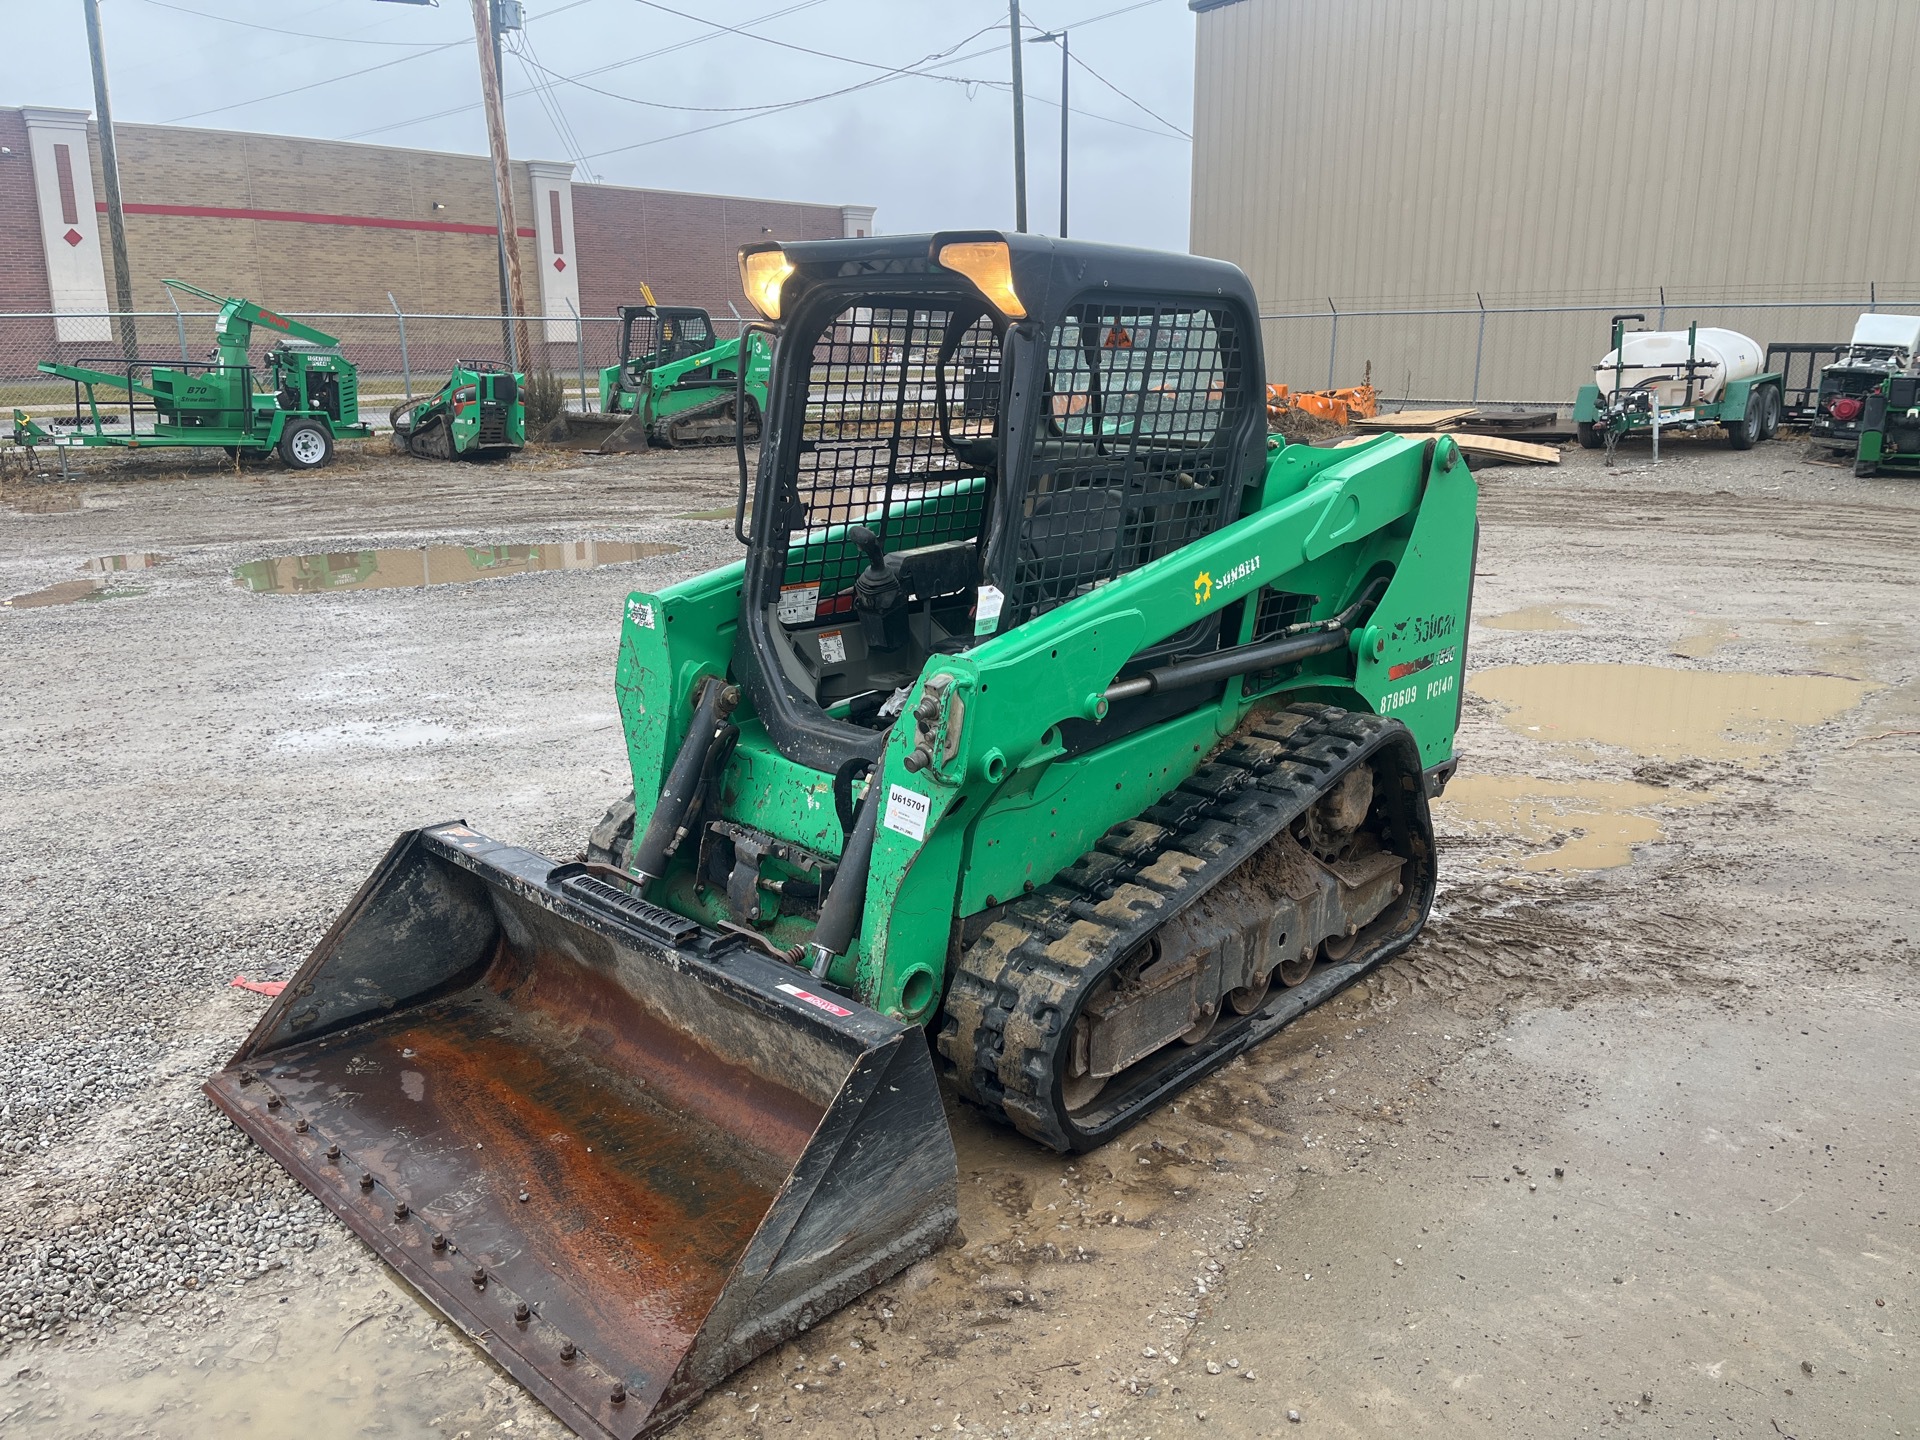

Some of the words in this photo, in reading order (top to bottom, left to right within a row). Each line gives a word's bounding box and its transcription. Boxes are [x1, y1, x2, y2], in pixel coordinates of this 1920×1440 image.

[259, 310, 290, 329] FINN
[755, 341, 762, 354] 3
[187, 386, 207, 394] B70
[1380, 685, 1417, 714] 878609
[891, 792, 926, 813] U615701
